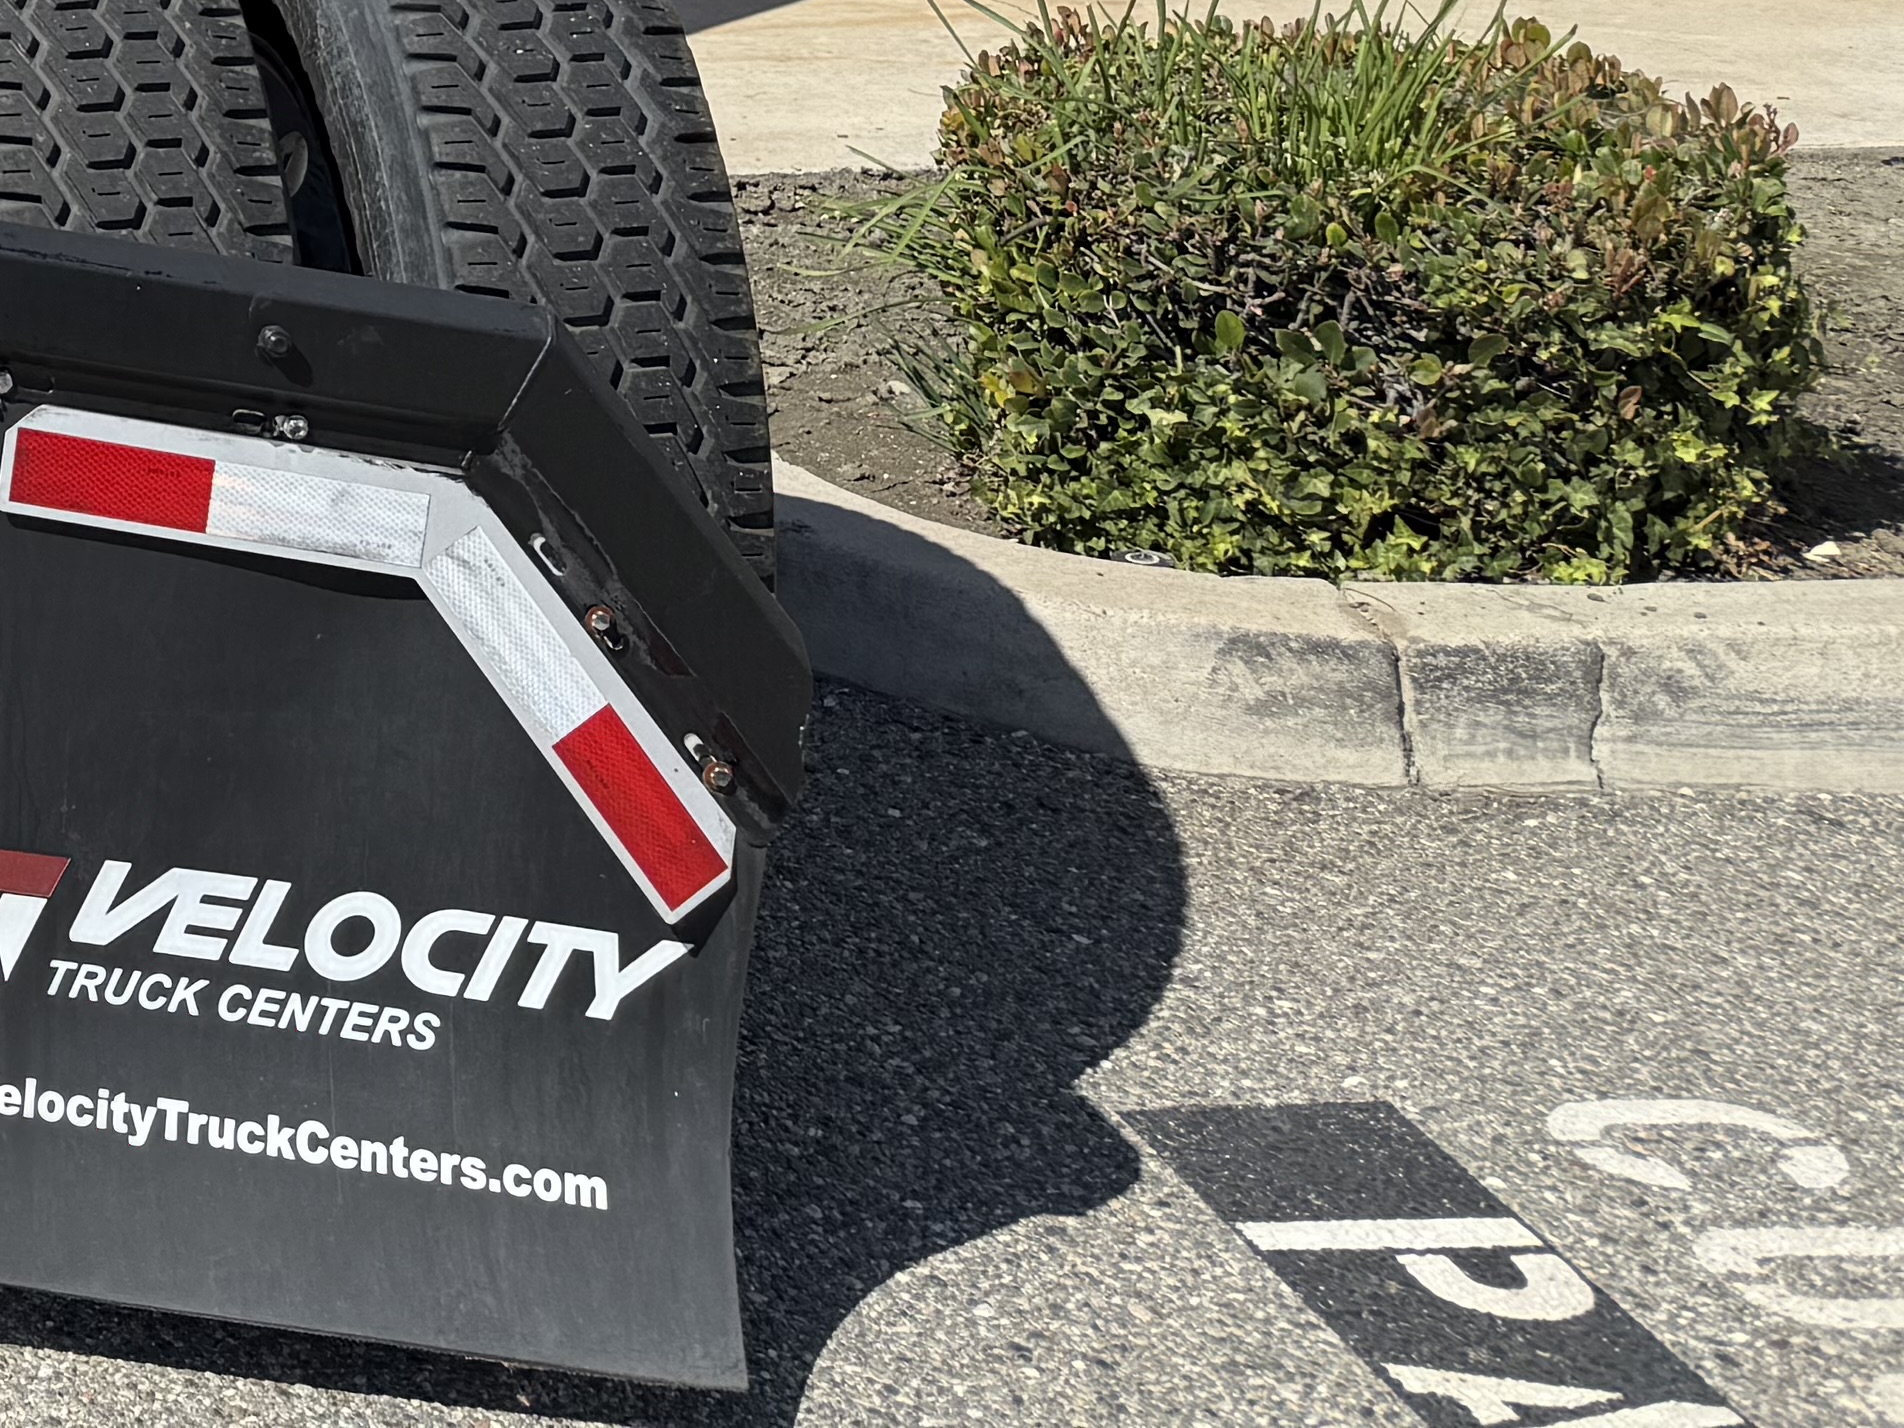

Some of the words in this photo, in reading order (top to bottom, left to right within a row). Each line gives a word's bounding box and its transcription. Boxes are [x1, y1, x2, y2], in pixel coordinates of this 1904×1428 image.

[69, 859, 693, 1021] VELOCITY
[47, 959, 210, 1016] TRUCK
[217, 984, 441, 1052] CENTERS
